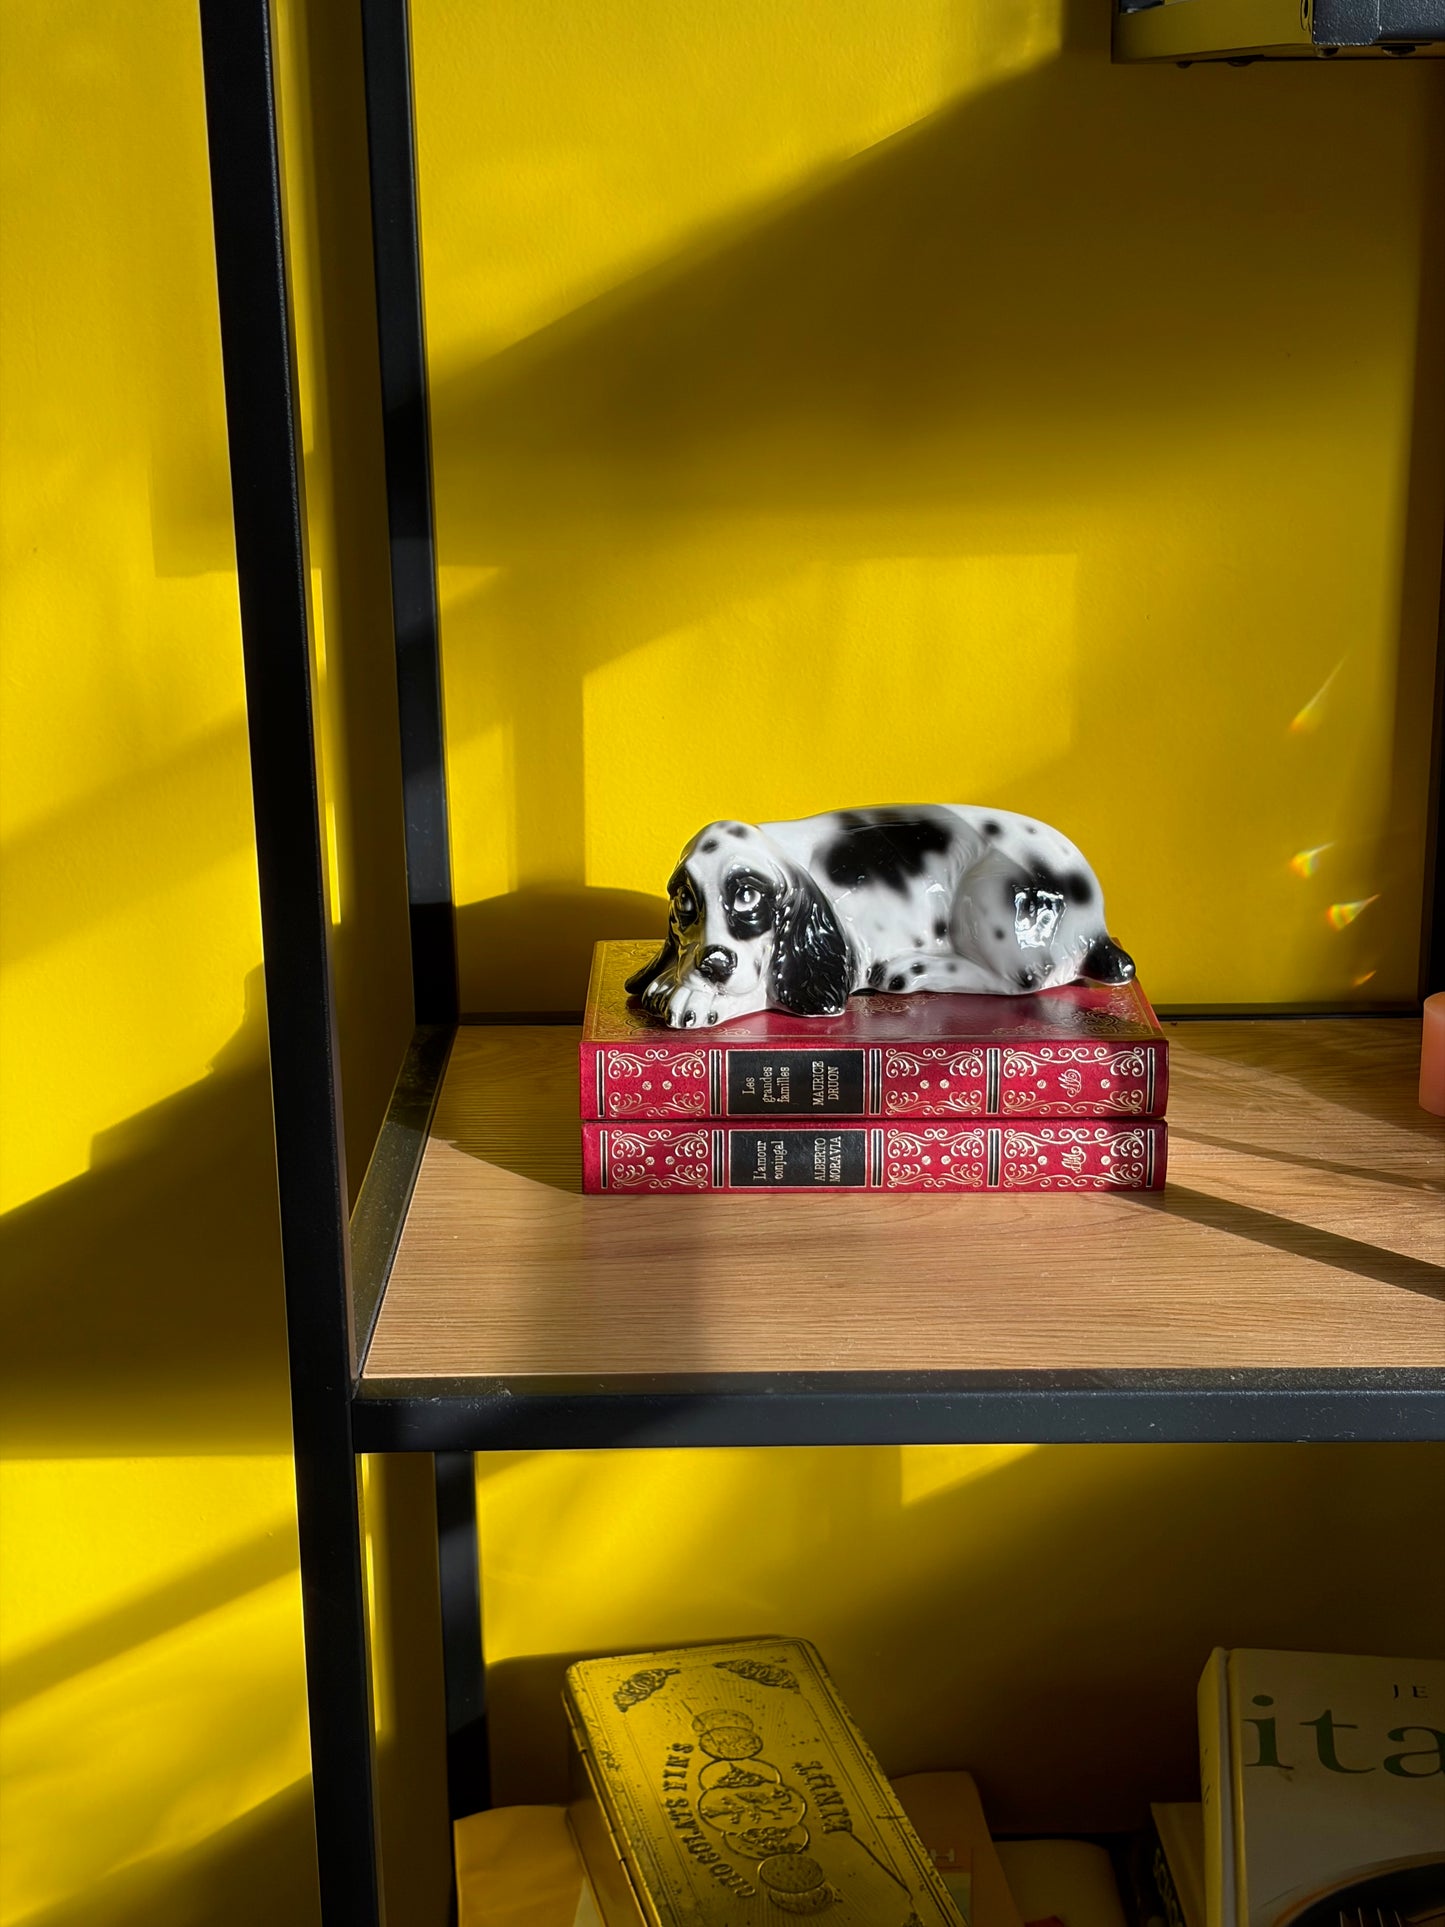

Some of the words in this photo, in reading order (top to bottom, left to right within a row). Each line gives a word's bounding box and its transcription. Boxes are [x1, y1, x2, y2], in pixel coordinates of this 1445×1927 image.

[742, 1077, 755, 1095] Les
[760, 1066, 776, 1103] grandes
[777, 1066, 790, 1103] familles
[812, 1060, 824, 1106] MAURICE
[828, 1066, 839, 1101] DRUON
[753, 1140, 767, 1180] L'amour
[771, 1140, 788, 1180] conjugal
[814, 1137, 826, 1182] ALBERTO
[829, 1135, 842, 1183] MORAVIA
[662, 1743, 694, 1792] FINS
[665, 1797, 756, 1897] CHOCOLATS
